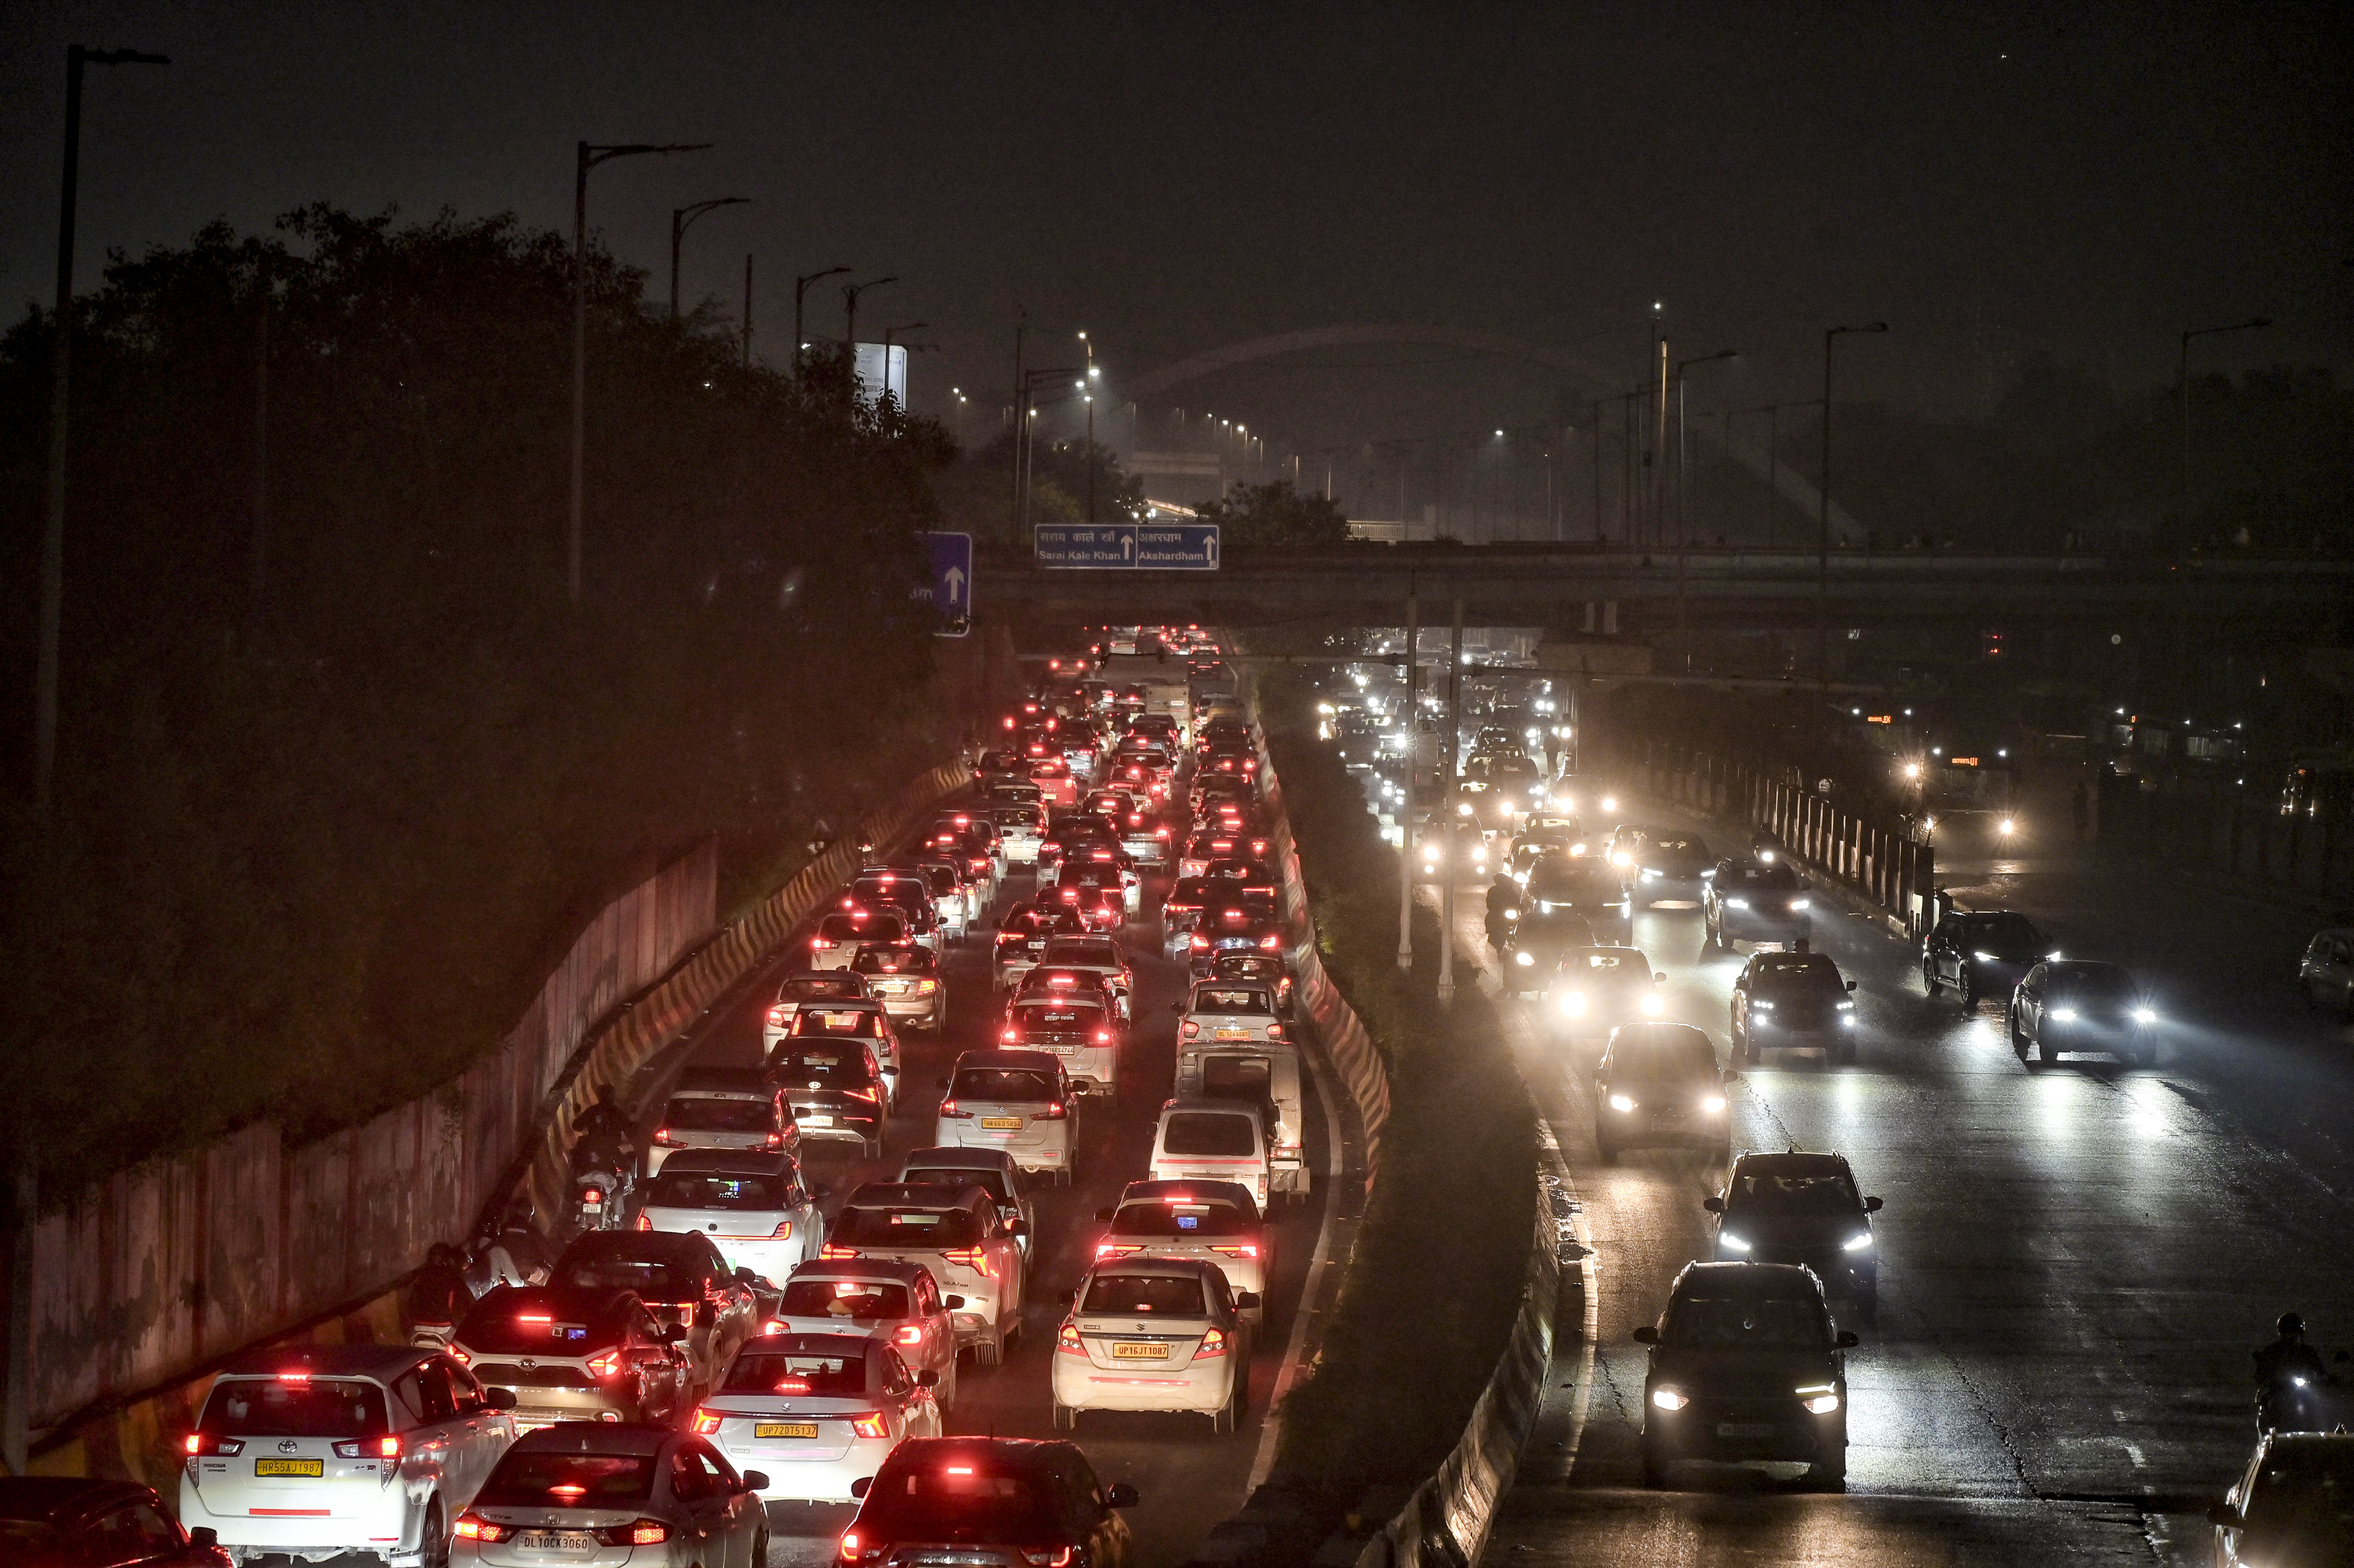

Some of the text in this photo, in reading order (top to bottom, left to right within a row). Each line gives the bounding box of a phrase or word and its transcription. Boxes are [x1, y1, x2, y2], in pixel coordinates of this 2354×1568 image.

[1073, 530, 1094, 542] काले
[1139, 533, 1182, 542] अक्षरधाम
[1040, 551, 1120, 560] Sarai Kale Khan
[1139, 551, 1203, 561] Akshardham
[1119, 1346, 1167, 1355] UP16JT1087
[763, 1426, 816, 1435] UP72DT5137
[262, 1463, 320, 1472] HR55AJ1987
[524, 1537, 588, 1549] DL10CK3060
